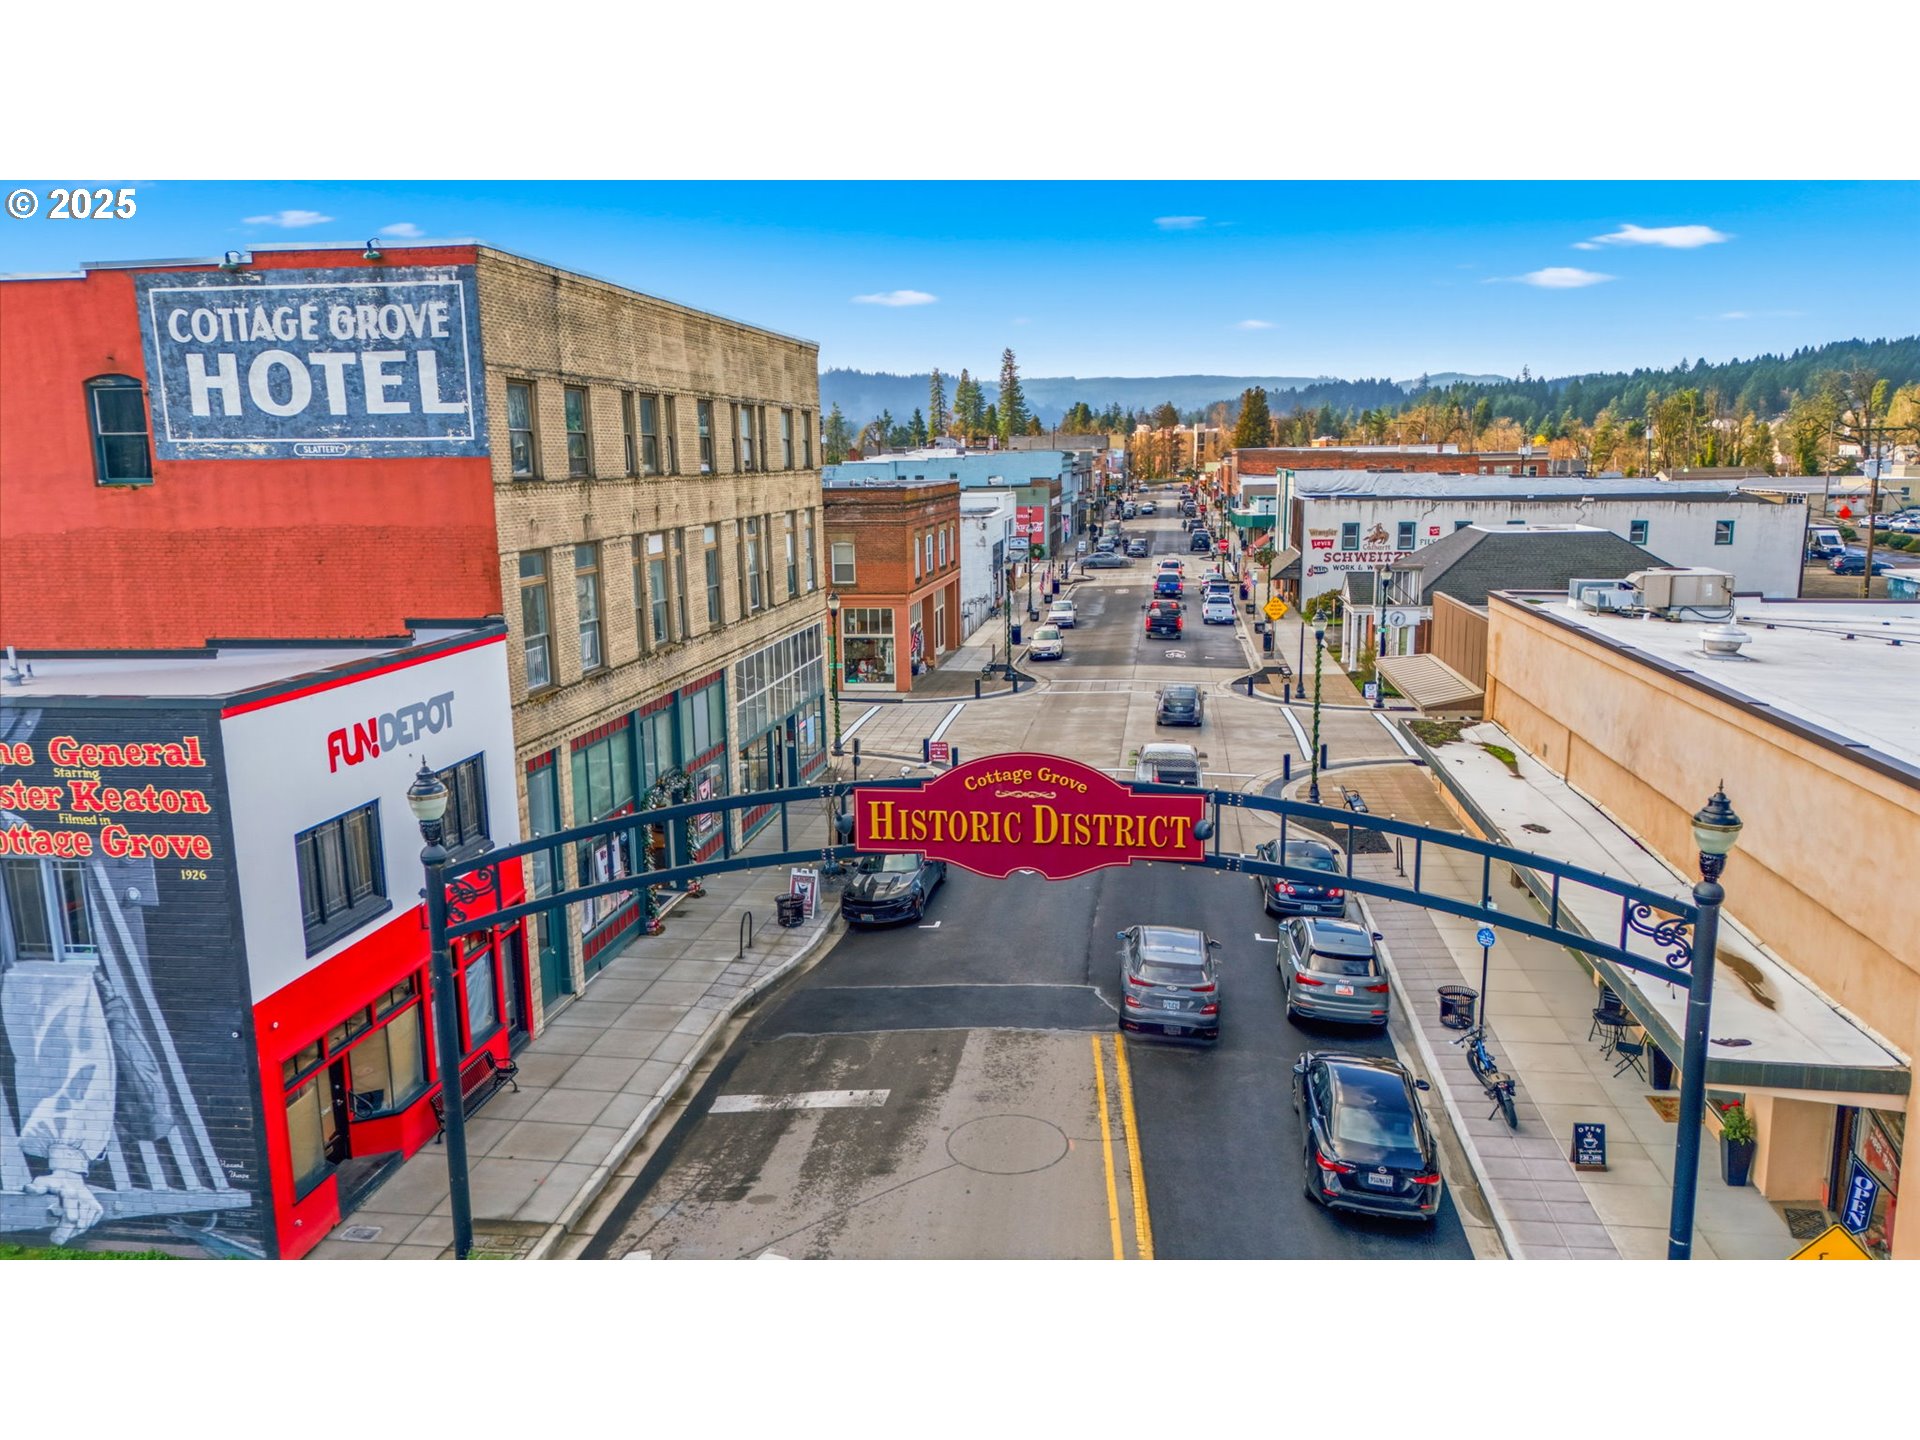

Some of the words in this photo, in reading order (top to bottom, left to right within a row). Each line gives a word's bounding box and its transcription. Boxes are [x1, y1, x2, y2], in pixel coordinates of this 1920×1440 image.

[167, 303, 320, 343] COTTAGE
[328, 301, 450, 341] GROVE
[185, 349, 466, 417] HOTEL
[303, 445, 340, 454] SLATTERY
[48, 735, 206, 768] General
[53, 767, 102, 781] Starring
[964, 768, 1033, 792] Cottage
[1037, 767, 1089, 794] Grove
[67, 780, 212, 814] Keaton
[58, 813, 97, 825] Filmed
[98, 813, 111, 825] in
[867, 801, 1022, 844] HISTORIC
[1031, 804, 1191, 848] DISTRICT
[100, 825, 213, 859] Grove
[180, 869, 208, 881] 1926
[1578, 1125, 1602, 1134] OPEN
[1847, 1176, 1874, 1227] OPEN
